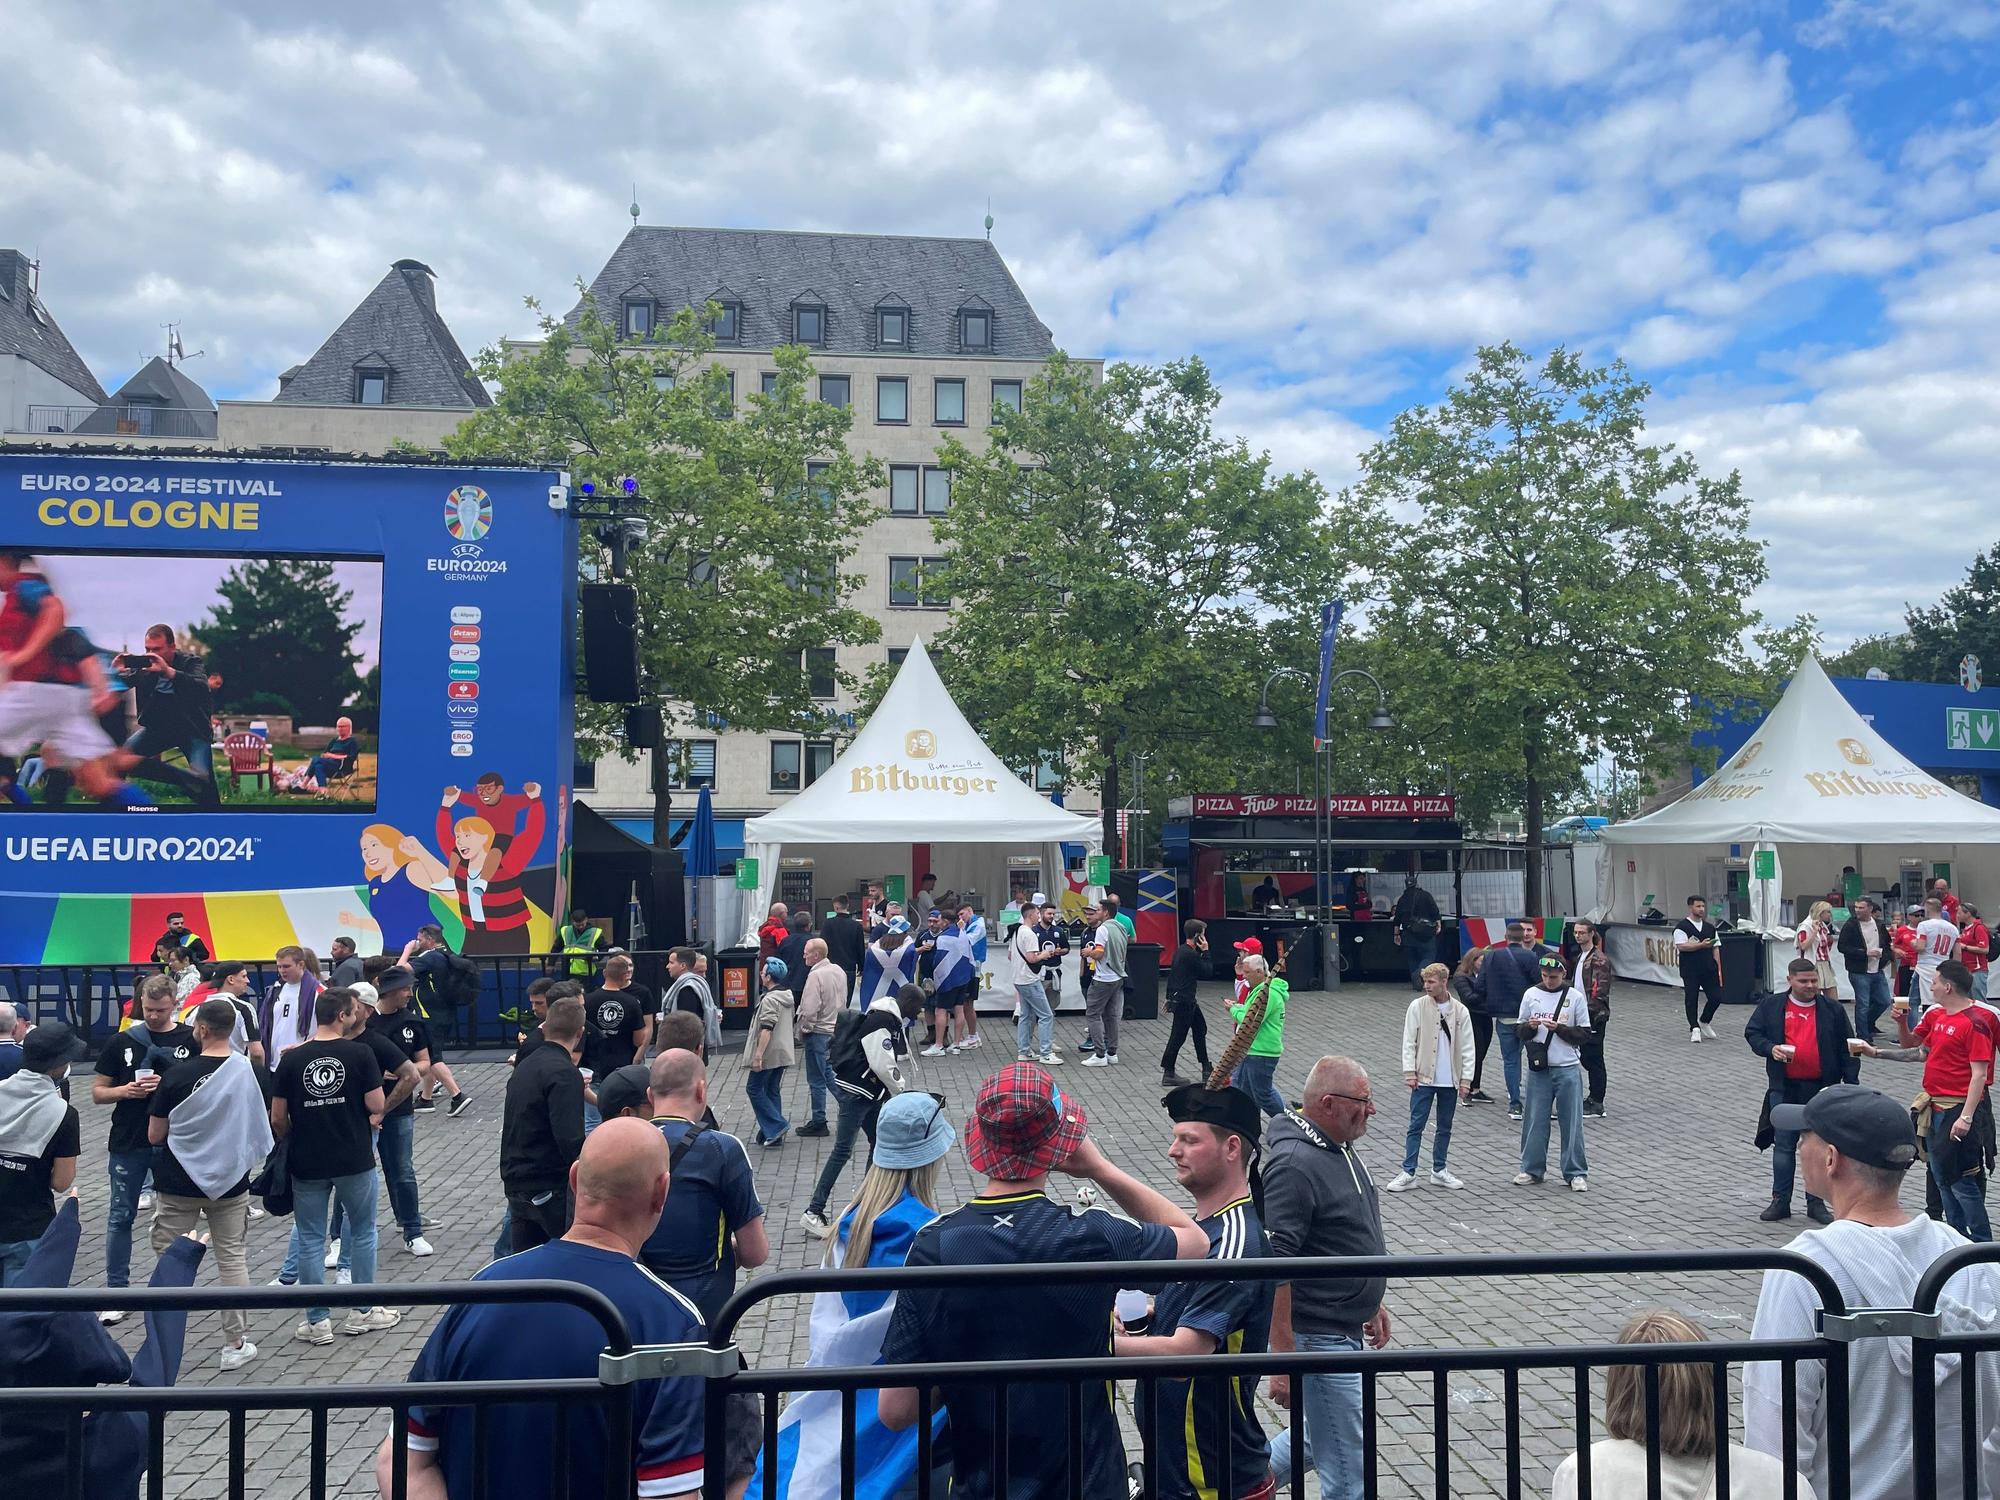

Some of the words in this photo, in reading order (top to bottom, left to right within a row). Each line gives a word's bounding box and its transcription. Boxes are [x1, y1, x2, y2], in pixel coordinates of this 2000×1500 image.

[21, 474, 90, 491] EURO
[95, 476, 161, 493] 2024
[166, 477, 282, 497] FESTIVAL
[38, 497, 259, 530] COLOGNE
[452, 545, 481, 557] UEFA
[427, 558, 507, 573] EURO2024
[444, 573, 488, 582] GERMANY
[448, 704, 477, 713] vivo
[848, 763, 998, 796] Bitburger
[1804, 769, 1948, 800] Bitburger
[1197, 799, 1235, 811] PIZZA
[1239, 796, 1279, 816] Fino
[1330, 800, 1367, 812] PIZZA
[1371, 800, 1409, 812] PIZZA
[1413, 800, 1451, 812] PIZZA
[1933, 934, 1951, 955] 10
[283, 1003, 290, 1018] 8
